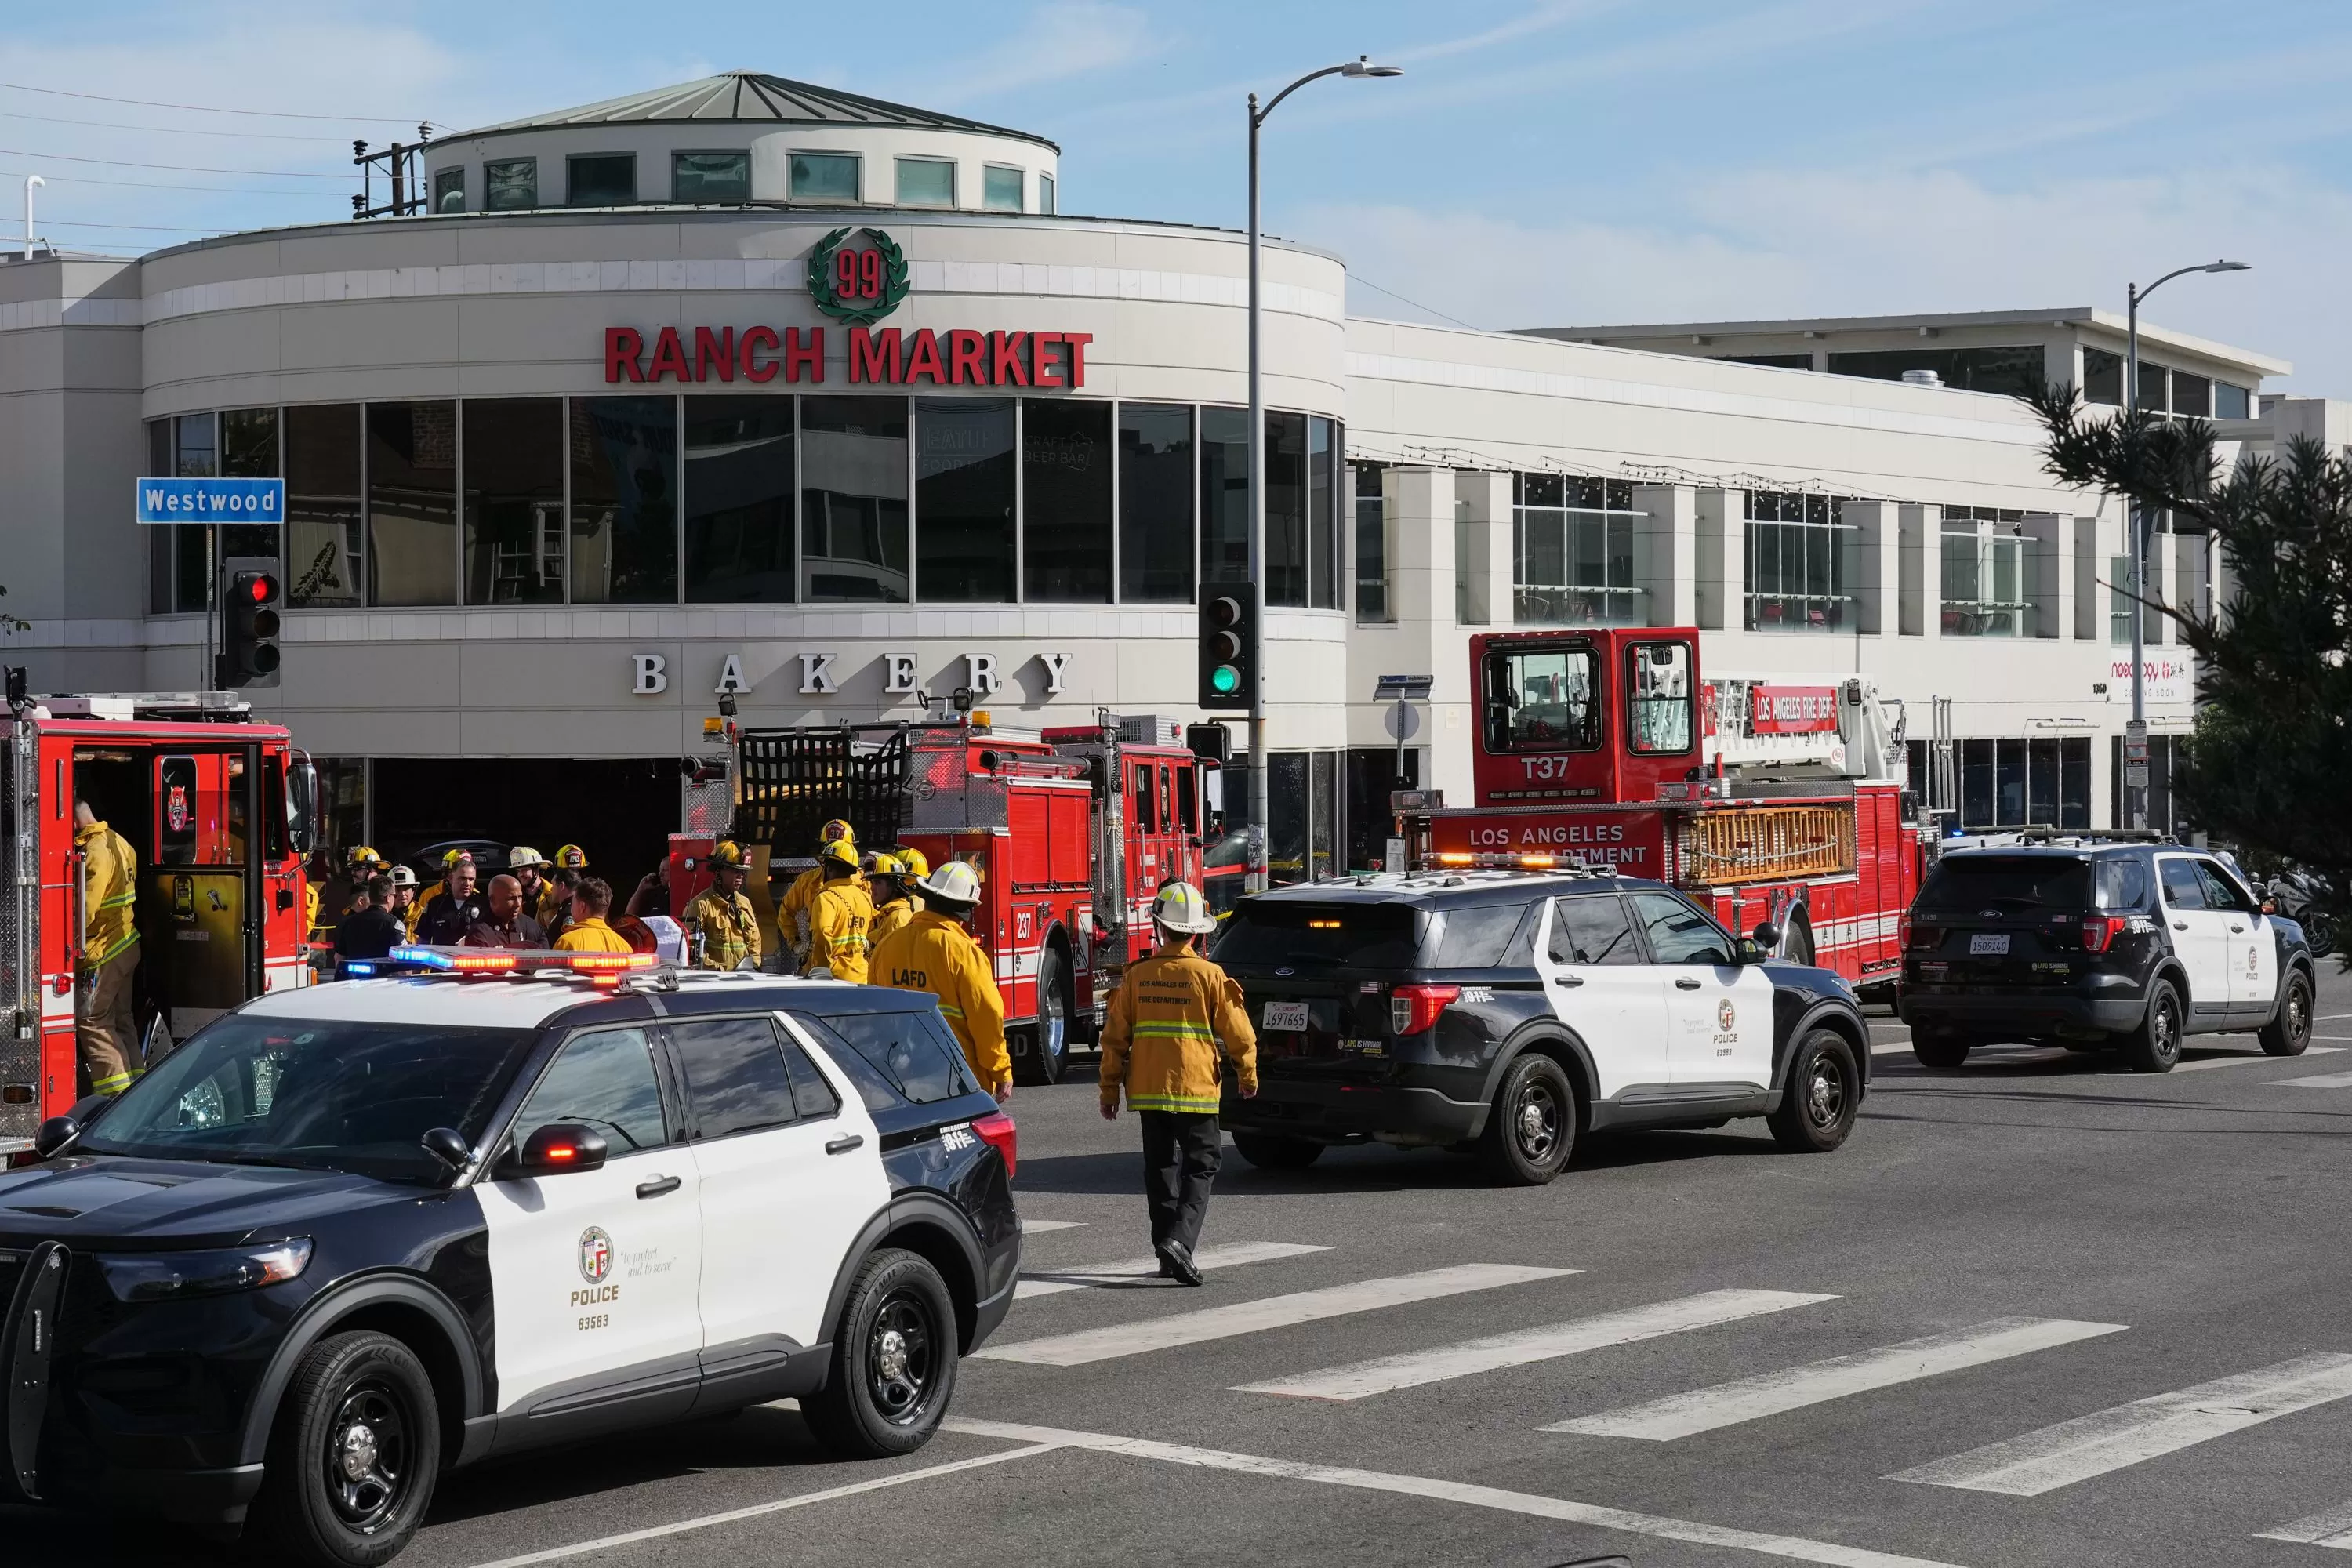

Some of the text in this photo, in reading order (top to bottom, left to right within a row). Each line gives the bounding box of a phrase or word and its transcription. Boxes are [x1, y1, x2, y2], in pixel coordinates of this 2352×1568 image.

[837, 249, 881, 299] 99
[604, 326, 1094, 388] RANCH MARKET
[1024, 434, 1066, 448] CRAFT
[1023, 450, 1086, 464] BEER BAR
[145, 489, 274, 512] Westwood
[631, 652, 1073, 695] BAKERY
[2092, 683, 2107, 694] 1360
[2124, 688, 2175, 697] CONG SOON
[1757, 696, 1835, 720] LOS ANGELES FIRE DEPT.
[1521, 757, 1568, 779] T37
[1470, 825, 1623, 846] LOS ANGELES
[1016, 913, 1031, 939] 237
[892, 969, 927, 988] LAFD
[1152, 996, 1192, 1005] DEPARTMENT
[1265, 1012, 1305, 1026] 1697665
[1713, 1033, 1738, 1044] POLICE
[939, 1122, 971, 1134] EMERGENCY
[632, 1247, 658, 1265] protect
[627, 1263, 642, 1278] and
[570, 1284, 619, 1308] POLICE
[579, 1314, 608, 1330] 83583
